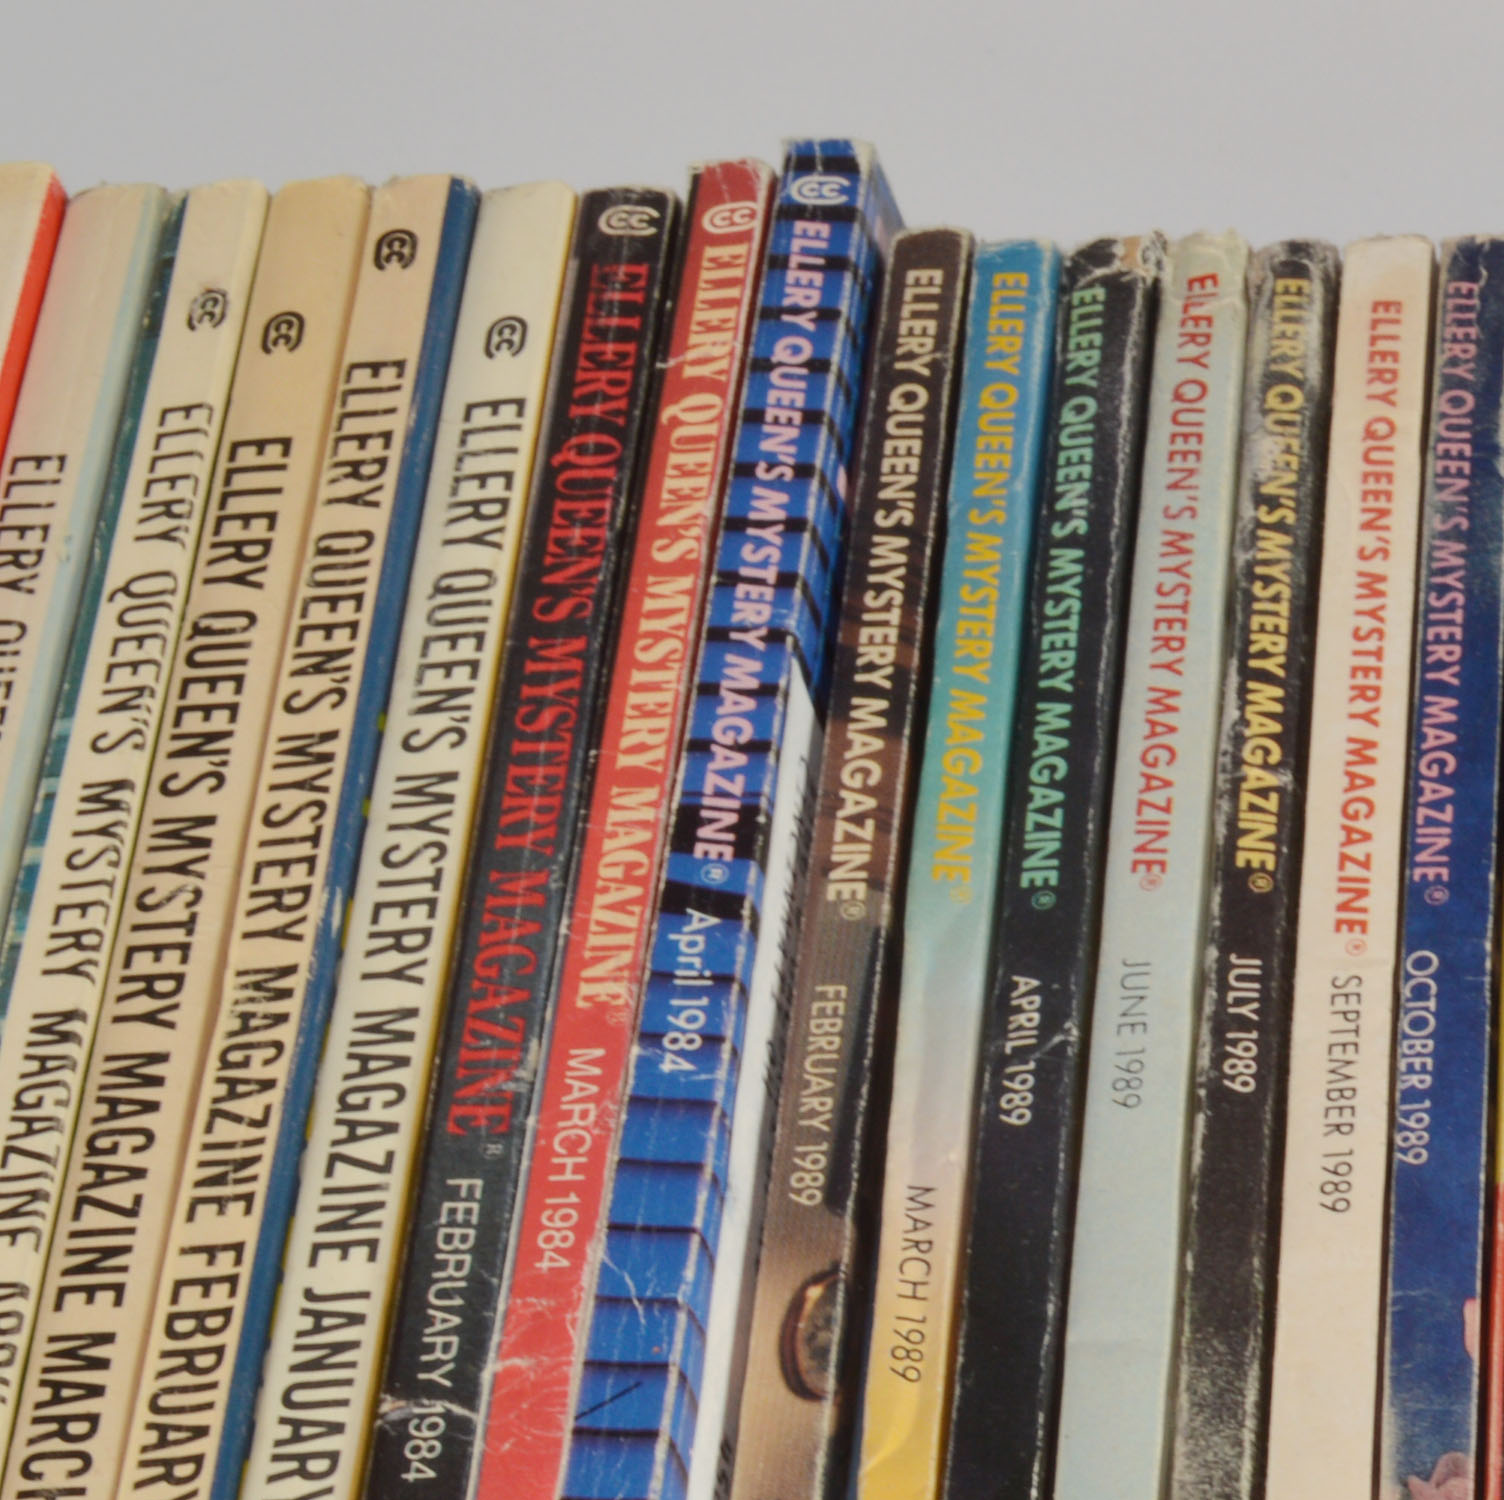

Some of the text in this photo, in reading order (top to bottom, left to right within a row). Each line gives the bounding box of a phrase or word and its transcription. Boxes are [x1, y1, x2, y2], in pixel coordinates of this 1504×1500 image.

[442, 397, 525, 548] ELLERY
[401, 568, 495, 752] QUEEN'S
[361, 771, 457, 984] MYSTERY
[659, 908, 720, 1079] April 1984
[788, 984, 846, 1205] FEBRUARY 1989
[999, 975, 1041, 1125] APRIL 1989
[1110, 958, 1150, 1109] JUNE 1989
[1222, 953, 1261, 1093] JULY 1989
[1319, 974, 1362, 1213] SEPTEMBER 1989
[1393, 950, 1438, 1164] OCTOBER 1989
[309, 1007, 418, 1266] MAGAZINE
[534, 1047, 604, 1272] MARCH 1984
[401, 1178, 482, 1481] FEBRUARY 1984
[889, 1185, 935, 1383] MARCH 1989
